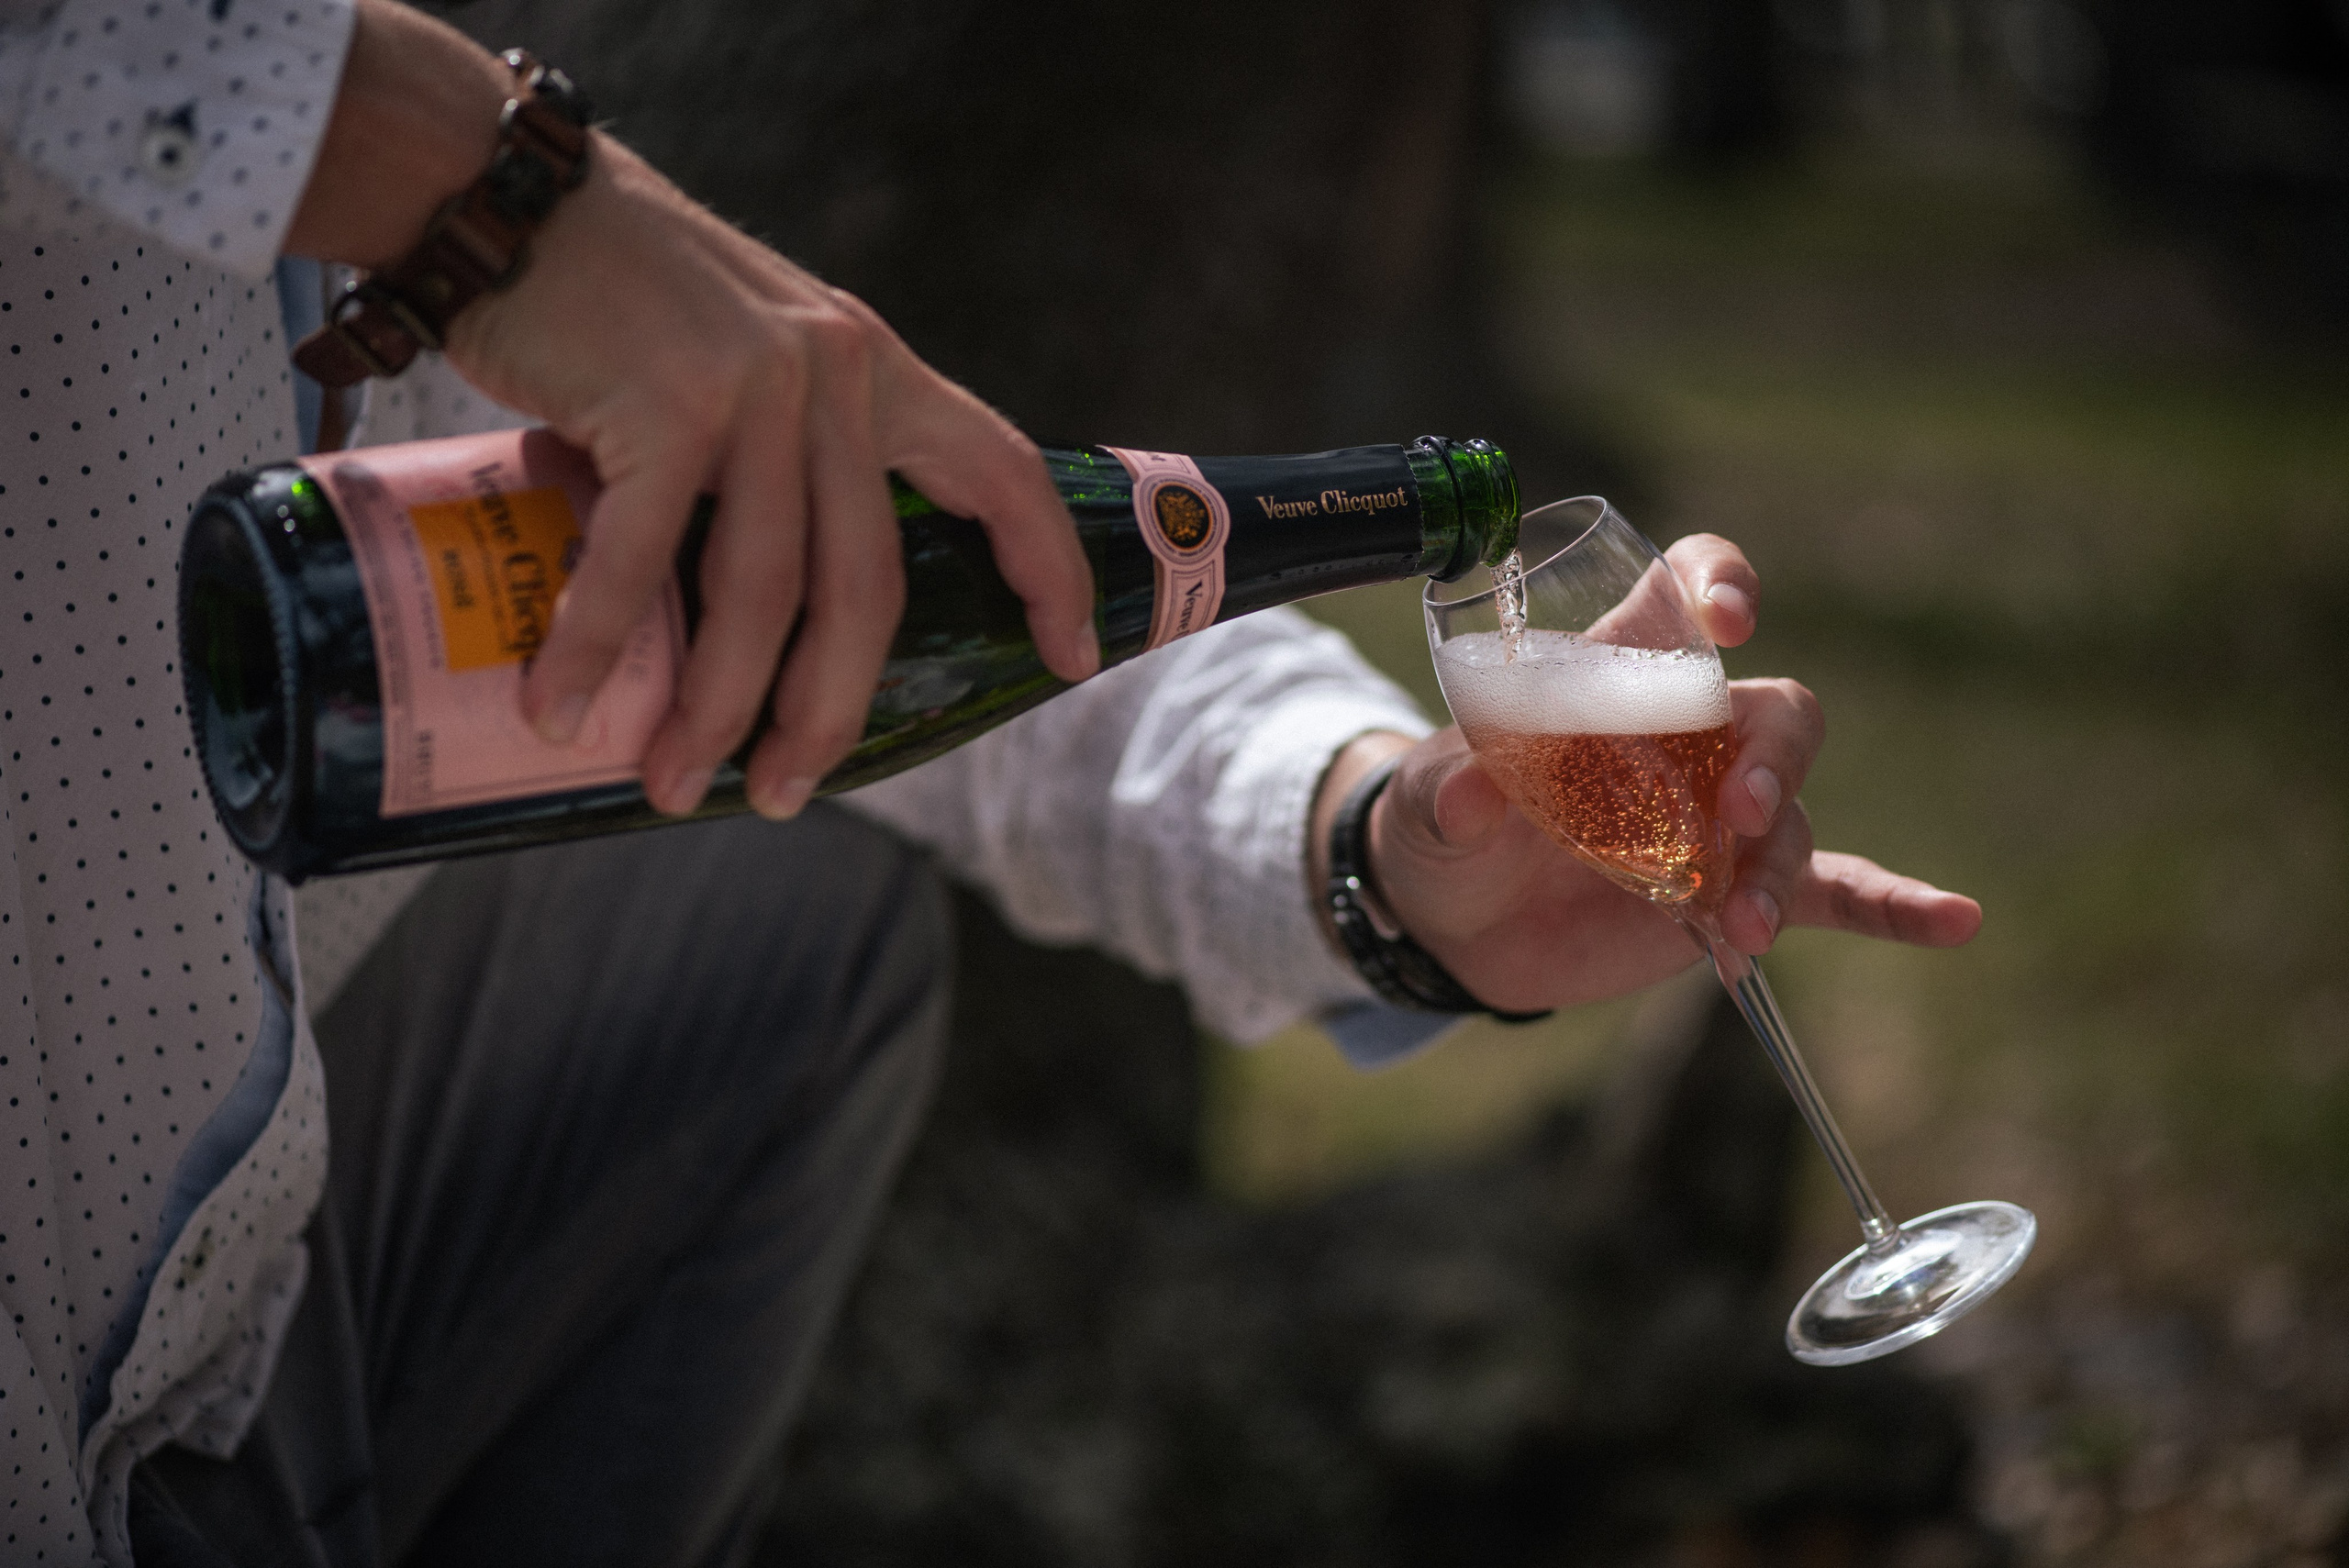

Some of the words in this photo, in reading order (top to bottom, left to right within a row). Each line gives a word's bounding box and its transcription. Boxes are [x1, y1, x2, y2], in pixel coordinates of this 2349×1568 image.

[1255, 495, 1319, 519] Veuve
[1320, 486, 1408, 516] Clicquot
[1176, 579, 1203, 633] Veuve
